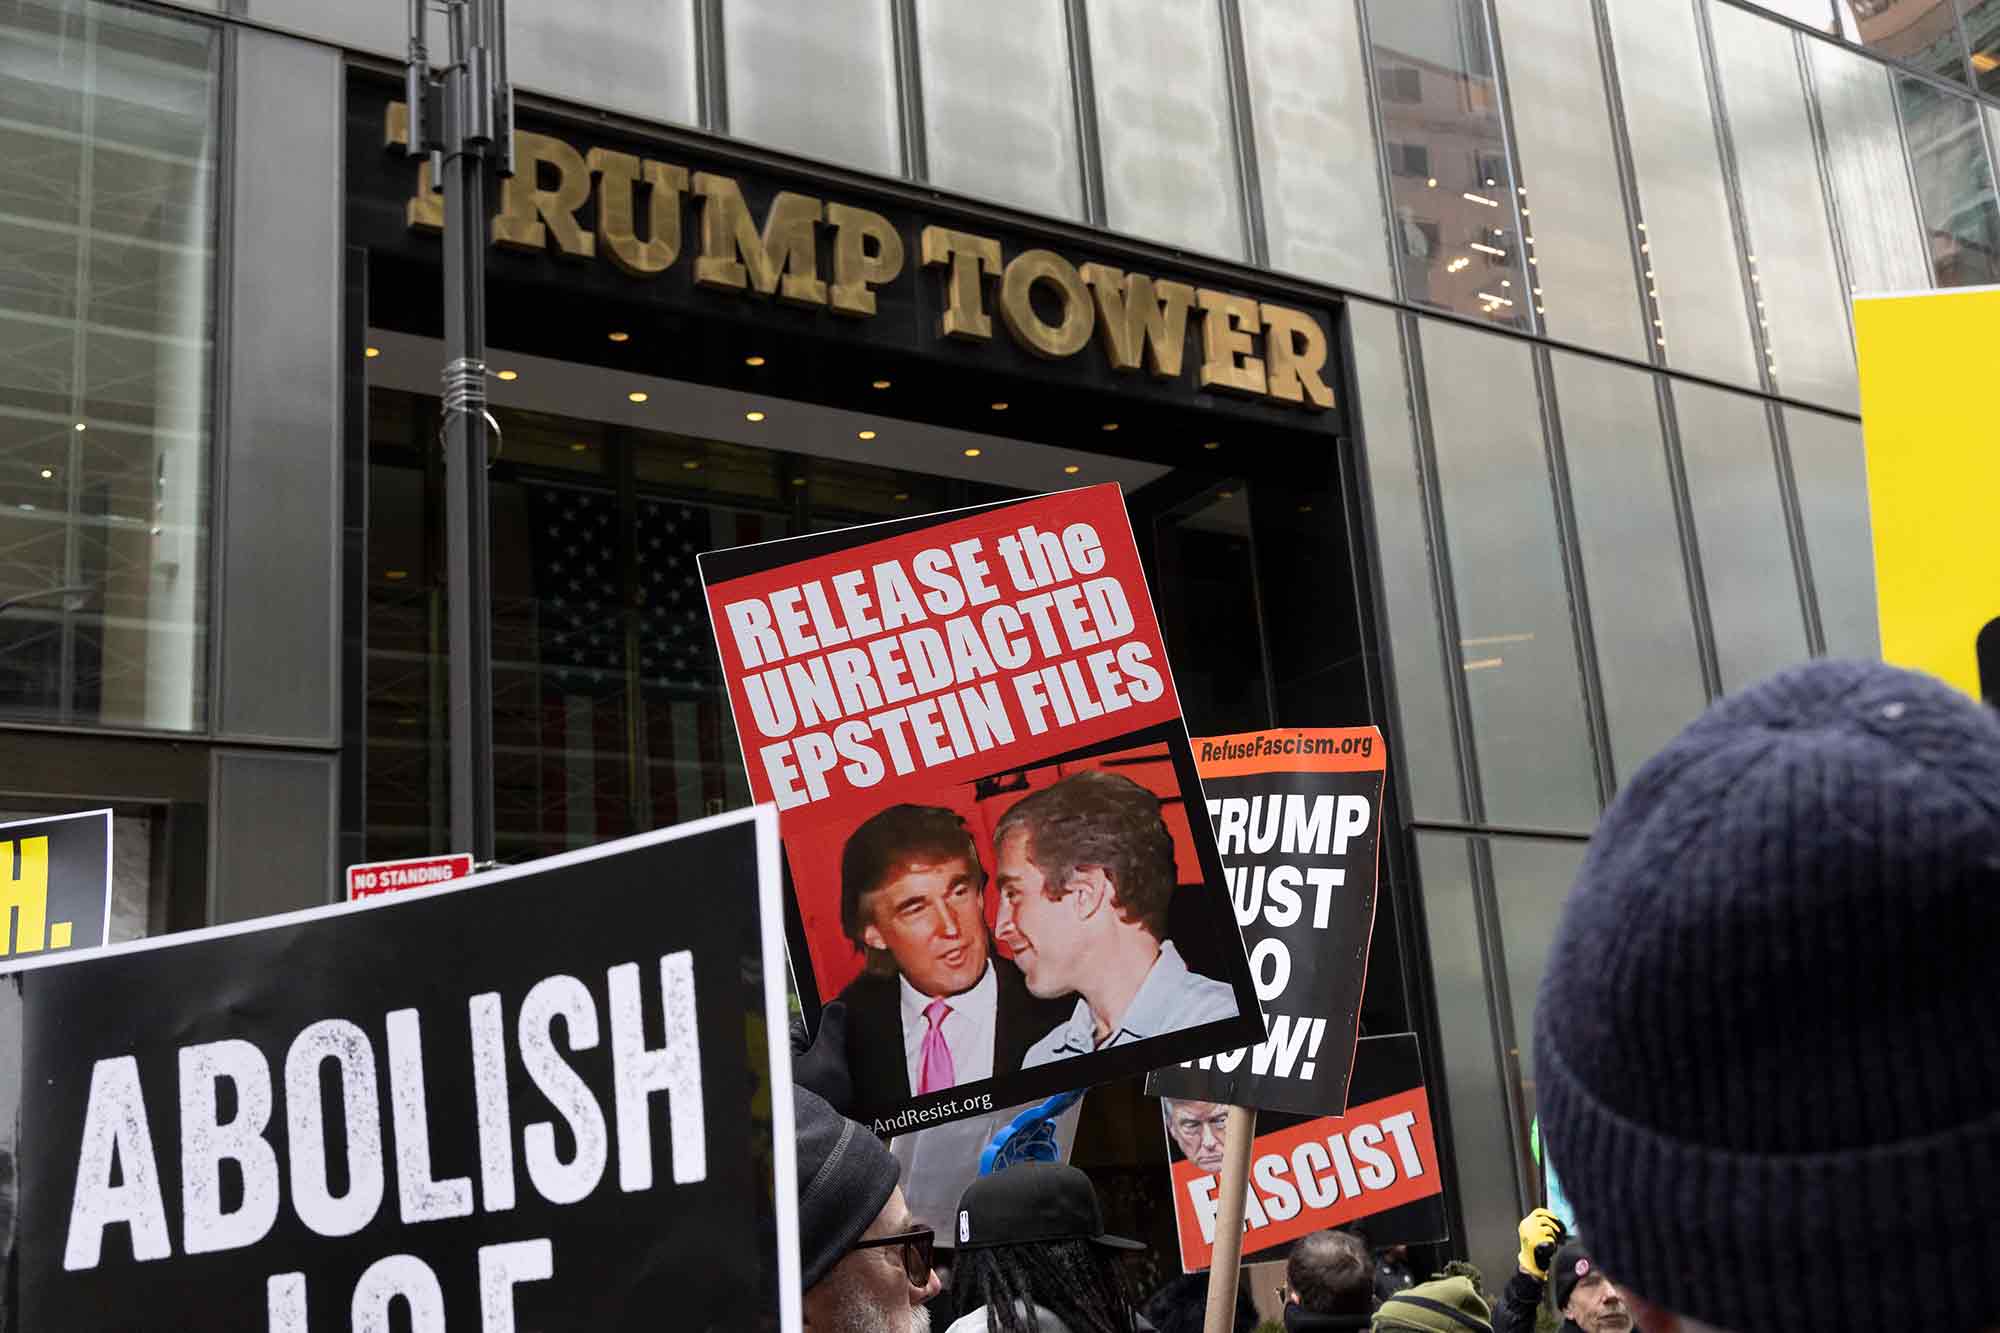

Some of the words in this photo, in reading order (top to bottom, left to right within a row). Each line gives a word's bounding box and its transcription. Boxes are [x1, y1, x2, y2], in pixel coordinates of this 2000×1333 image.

[922, 225, 1336, 409] TOWER
[725, 537, 999, 670] RELEASE
[998, 522, 1106, 593] the
[742, 576, 1135, 738] UNREDACTED
[759, 681, 1017, 812] EPSTEIN
[1012, 640, 1165, 736] FILES
[1201, 734, 1373, 763] RefuseFascism.org
[355, 874, 377, 888] NO
[380, 865, 453, 887] STANDING
[1224, 864, 1345, 929] UST
[1250, 937, 1292, 1001] O
[1180, 1013, 1327, 1080] W!
[63, 950, 707, 1272] ABOLISH
